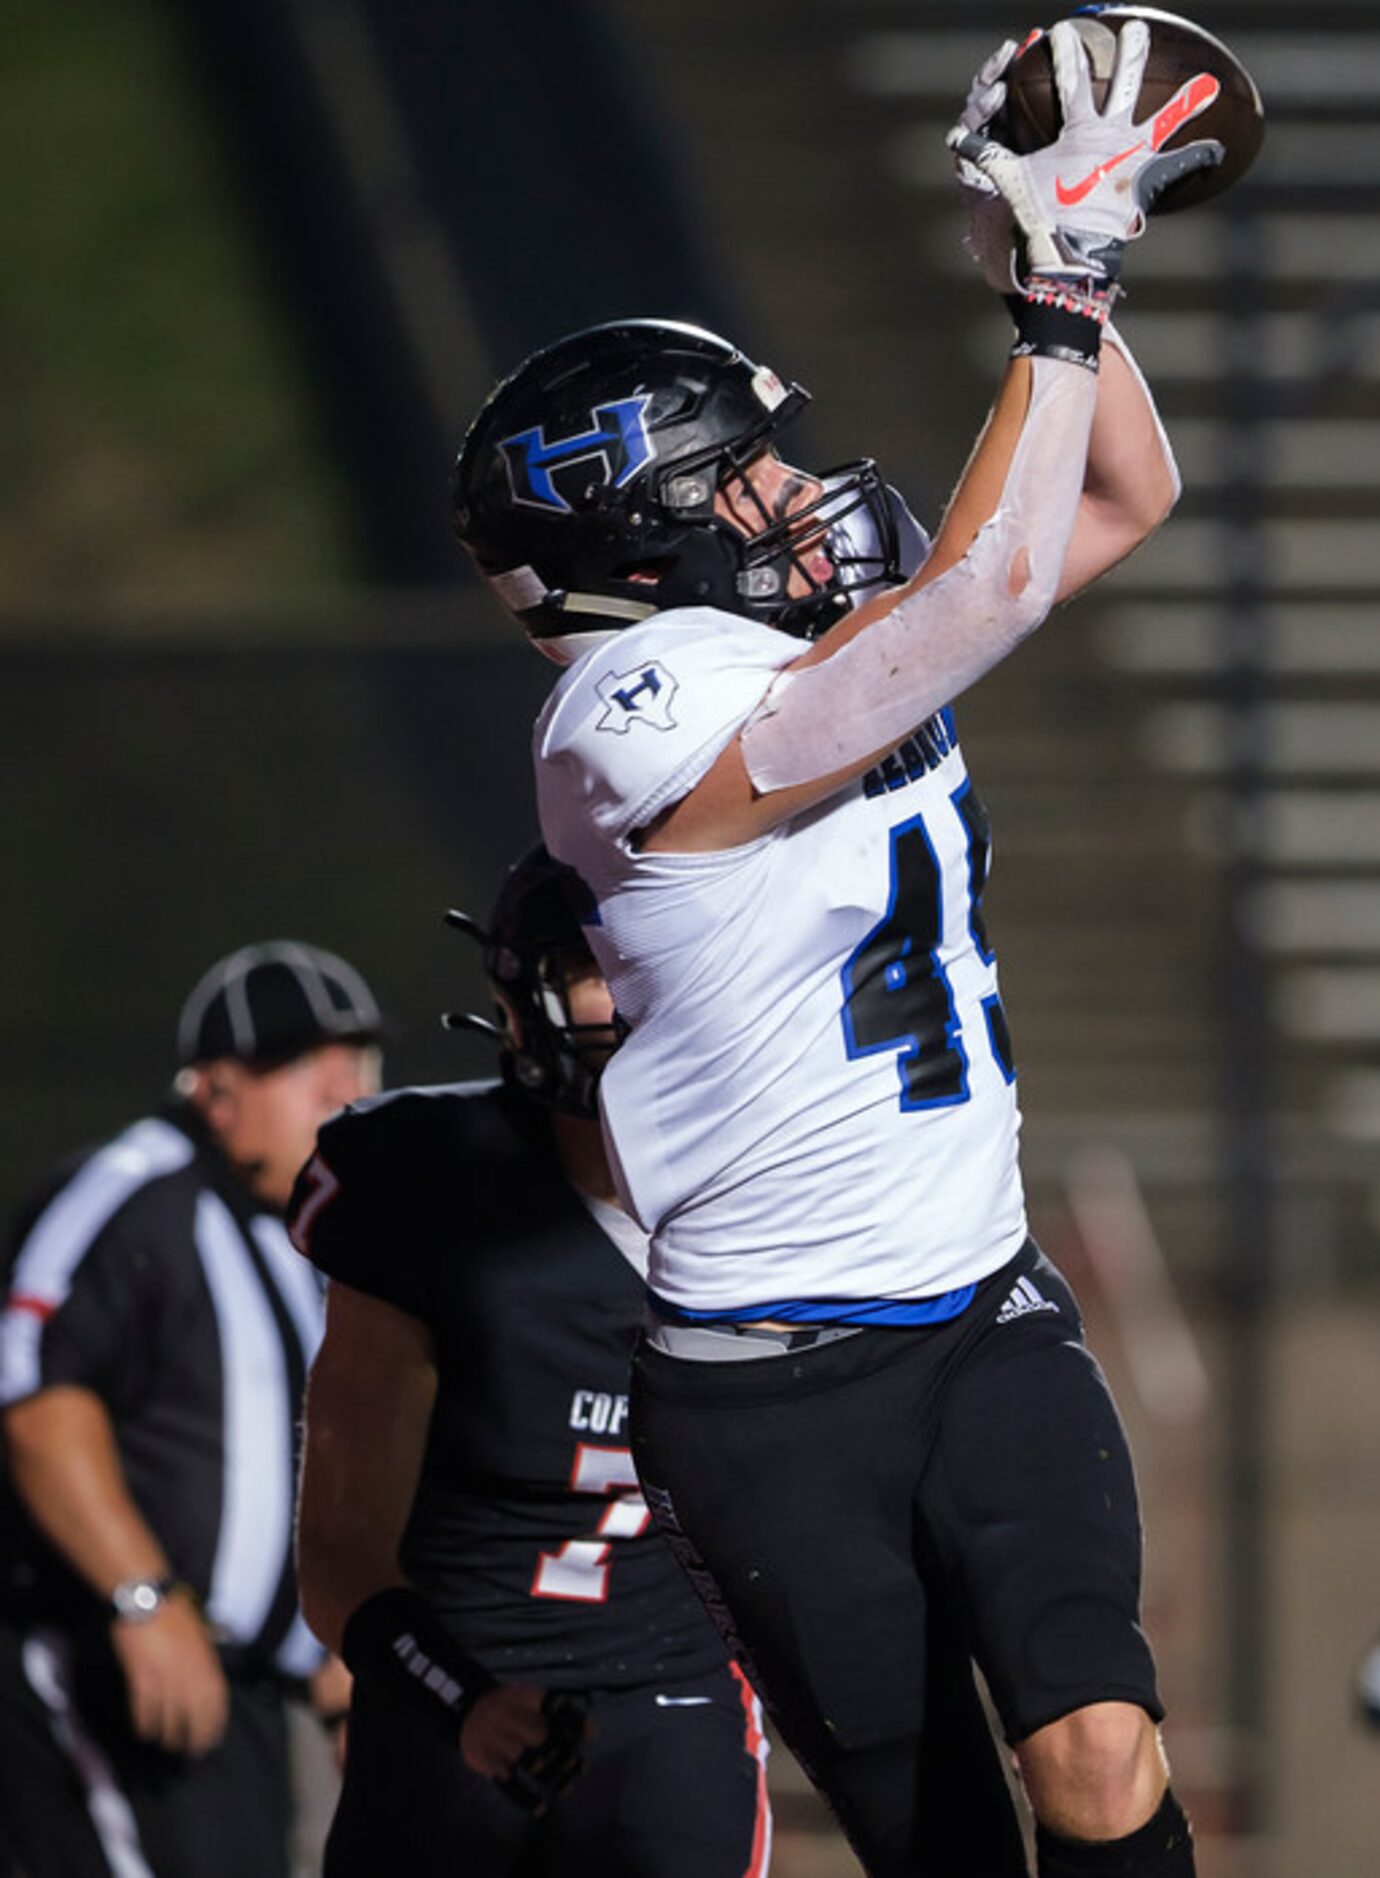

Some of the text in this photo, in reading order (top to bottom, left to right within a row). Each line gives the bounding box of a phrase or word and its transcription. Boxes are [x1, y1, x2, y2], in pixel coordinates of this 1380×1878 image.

[498, 393, 657, 514] H
[611, 667, 662, 712] H
[530, 1441, 651, 1604] 7
